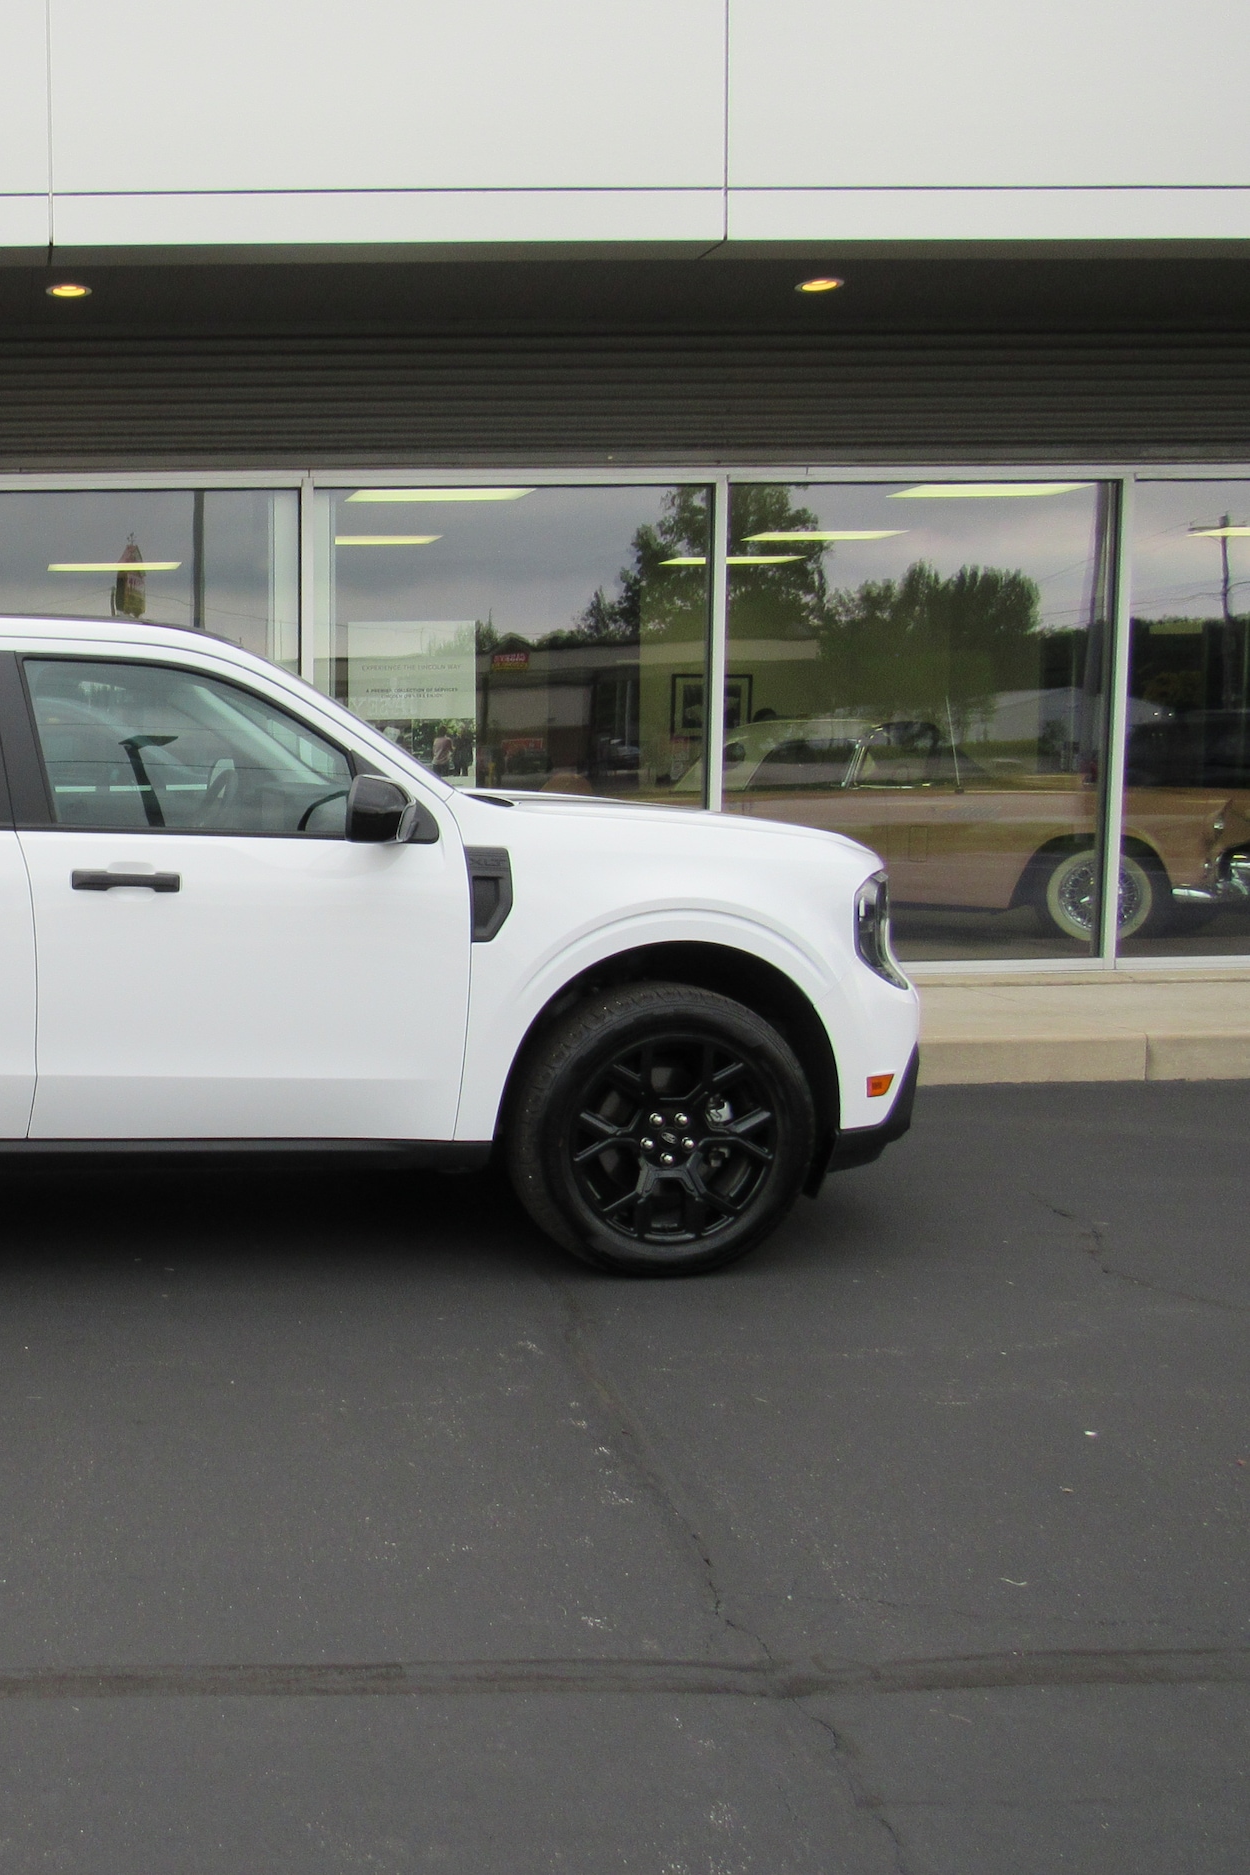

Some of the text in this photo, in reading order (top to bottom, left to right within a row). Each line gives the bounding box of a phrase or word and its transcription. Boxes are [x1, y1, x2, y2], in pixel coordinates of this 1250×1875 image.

[361, 663, 462, 672] EXPERIENCE THE LINCOLN WAY
[469, 858, 506, 867] XLT
